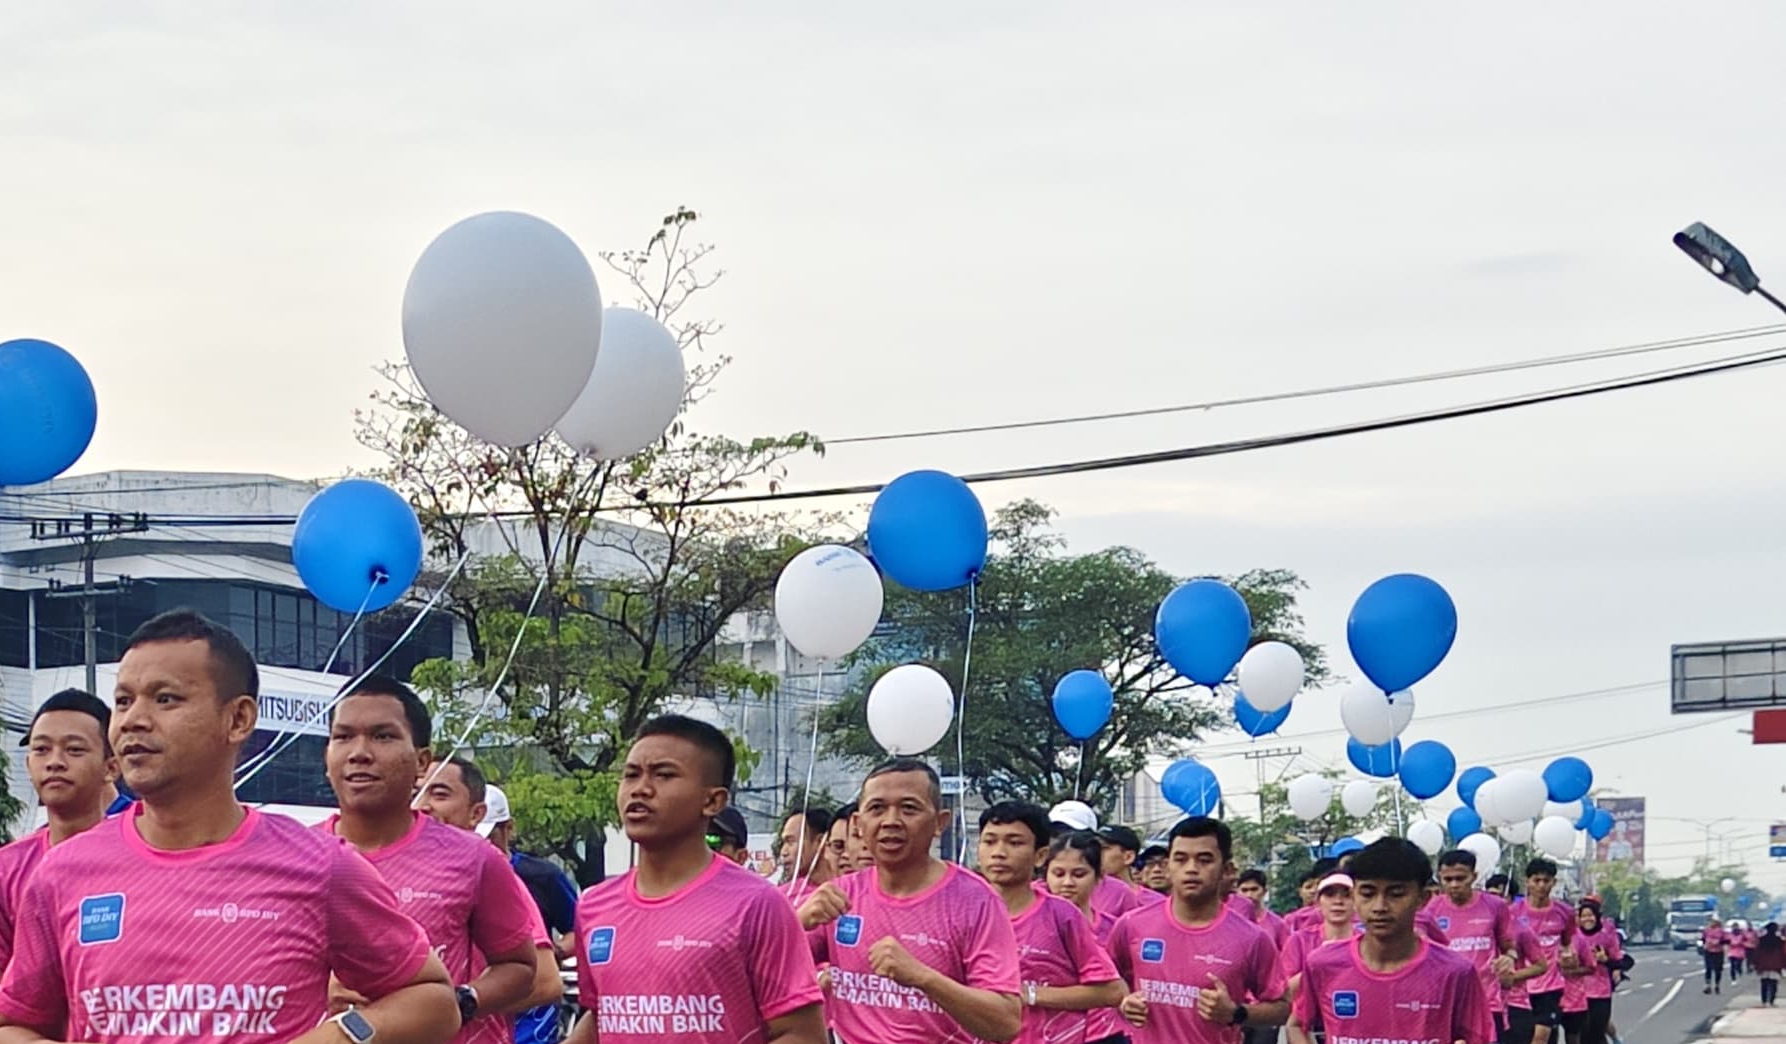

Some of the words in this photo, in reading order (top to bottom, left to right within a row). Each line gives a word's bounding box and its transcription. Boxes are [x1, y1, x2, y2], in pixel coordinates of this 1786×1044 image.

[257, 695, 327, 725] MITSUBISH
[598, 994, 725, 1014] RKEMBANG
[212, 1011, 278, 1037] BAIK
[598, 1015, 665, 1034] MAKIN
[672, 1014, 725, 1033] BAIK
